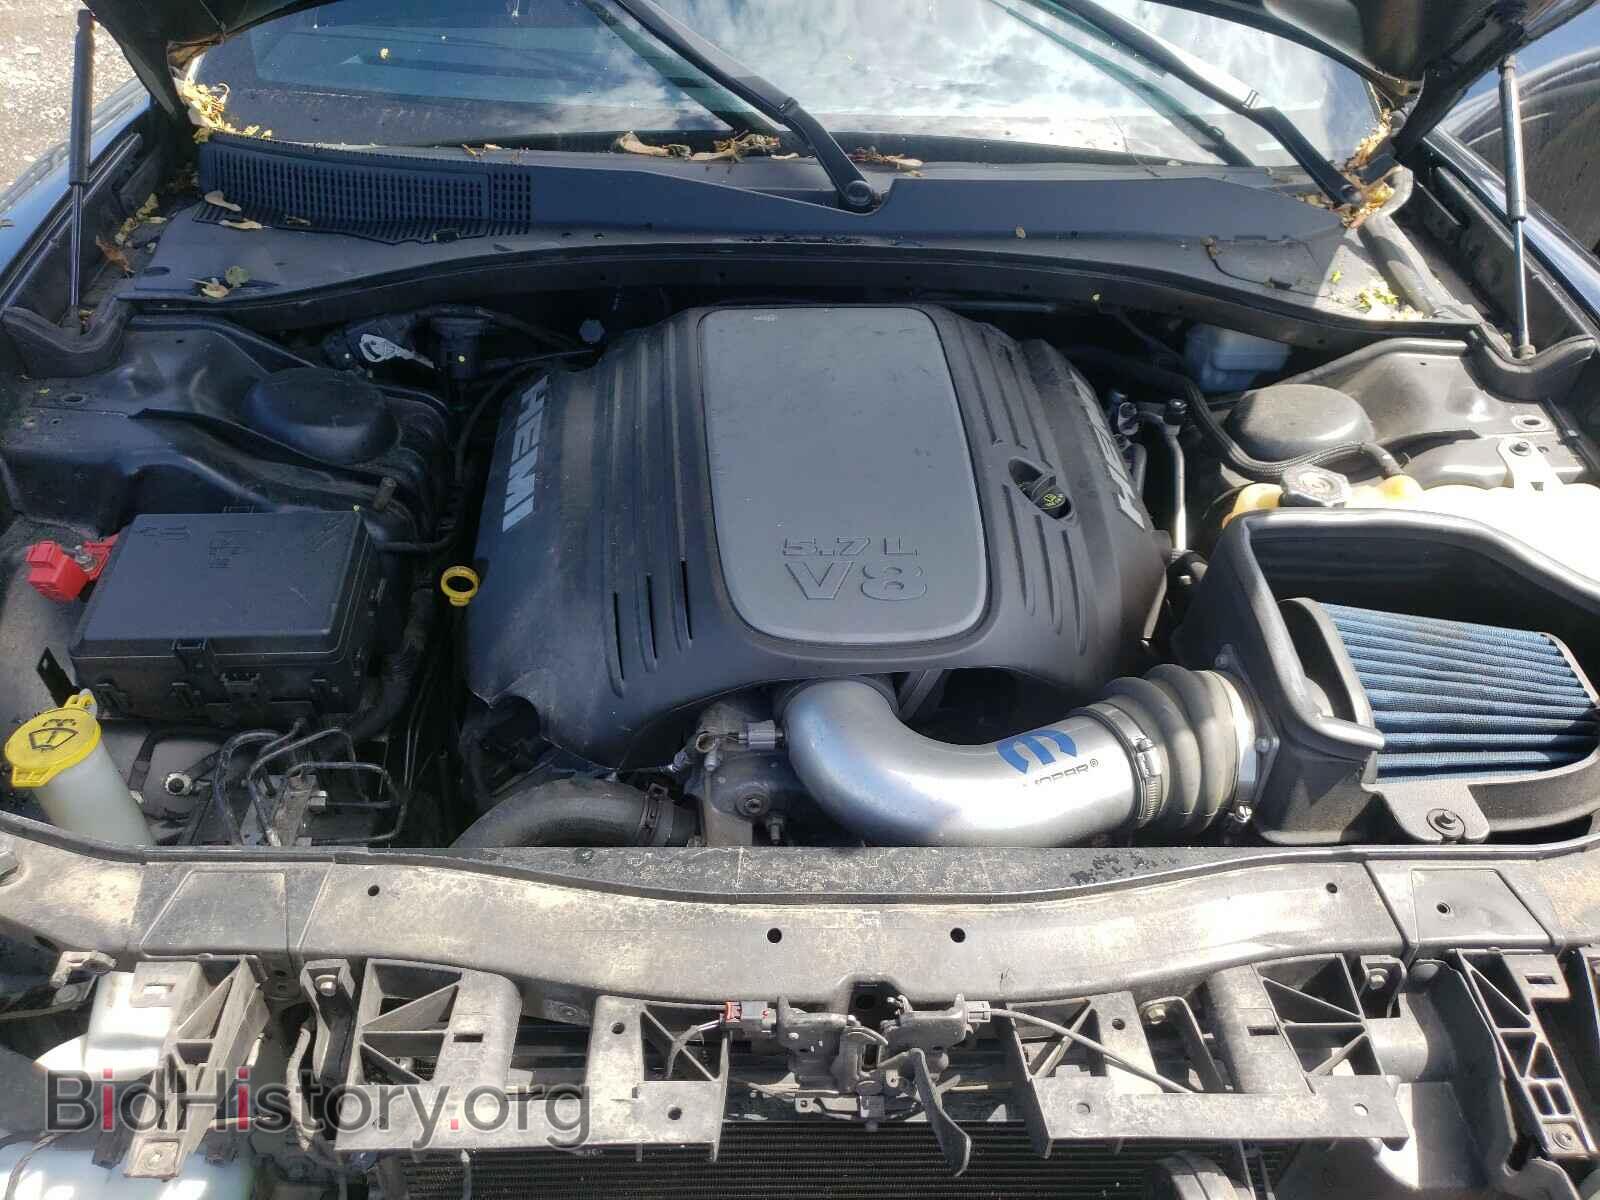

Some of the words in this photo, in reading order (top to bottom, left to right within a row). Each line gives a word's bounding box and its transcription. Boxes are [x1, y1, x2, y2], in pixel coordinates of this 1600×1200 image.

[502, 375, 550, 532] HEMI
[783, 535, 871, 557] 5.7
[883, 535, 918, 557] L
[784, 560, 928, 601] V8
